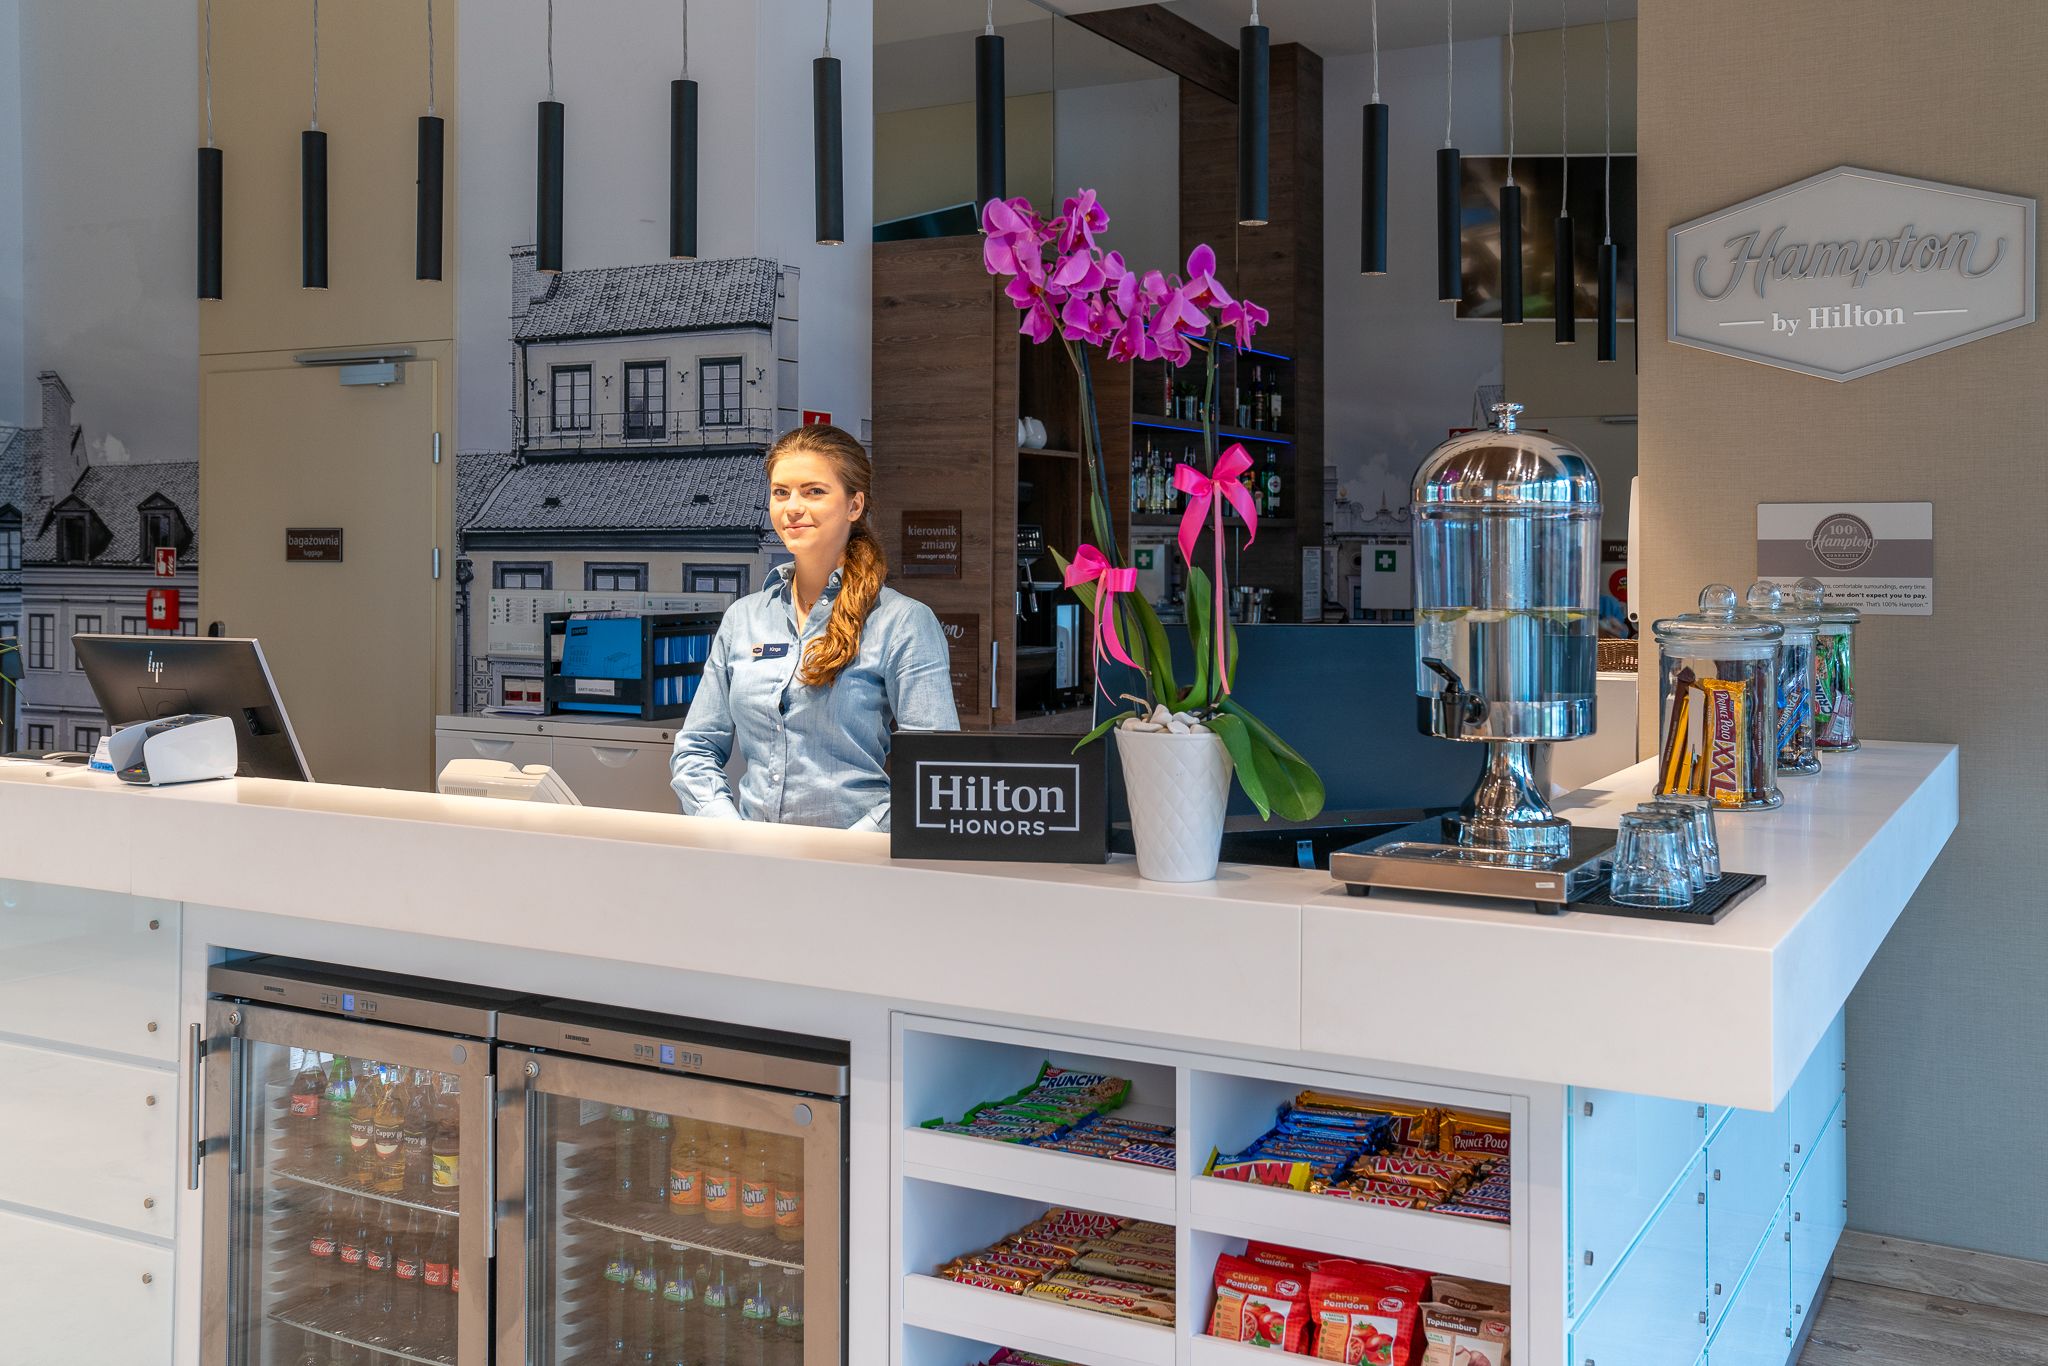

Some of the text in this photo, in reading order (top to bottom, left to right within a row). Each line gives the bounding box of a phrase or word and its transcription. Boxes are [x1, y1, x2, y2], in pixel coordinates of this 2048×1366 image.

[1694, 224, 2006, 301] Hampton
[1771, 303, 1906, 336] by Hilton
[908, 525, 957, 536] kierownik
[921, 539, 957, 552] zmiany
[1805, 533, 1879, 550] Hampton
[1708, 740, 1738, 800] XXL
[929, 775, 1066, 813] Hilton
[950, 819, 1045, 836] HONORS
[1038, 1075, 1105, 1088] CRUNCHY
[375, 1129, 396, 1140] Cappy
[1454, 1133, 1508, 1149] PRINCE POLO
[1369, 1155, 1453, 1183] TWIX
[671, 1178, 691, 1191] ANTA
[1359, 1178, 1442, 1203] TWIX
[1059, 1209, 1127, 1230] TWIX
[985, 1253, 1054, 1272] TWIX
[1225, 1278, 1268, 1292] Pomidora
[1232, 1272, 1260, 1282] Chrup
[1323, 1299, 1370, 1311] Pomidora
[1329, 1292, 1360, 1303] Chrup
[1447, 1297, 1478, 1310] Chrup
[1426, 1317, 1478, 1333] Topinambura
